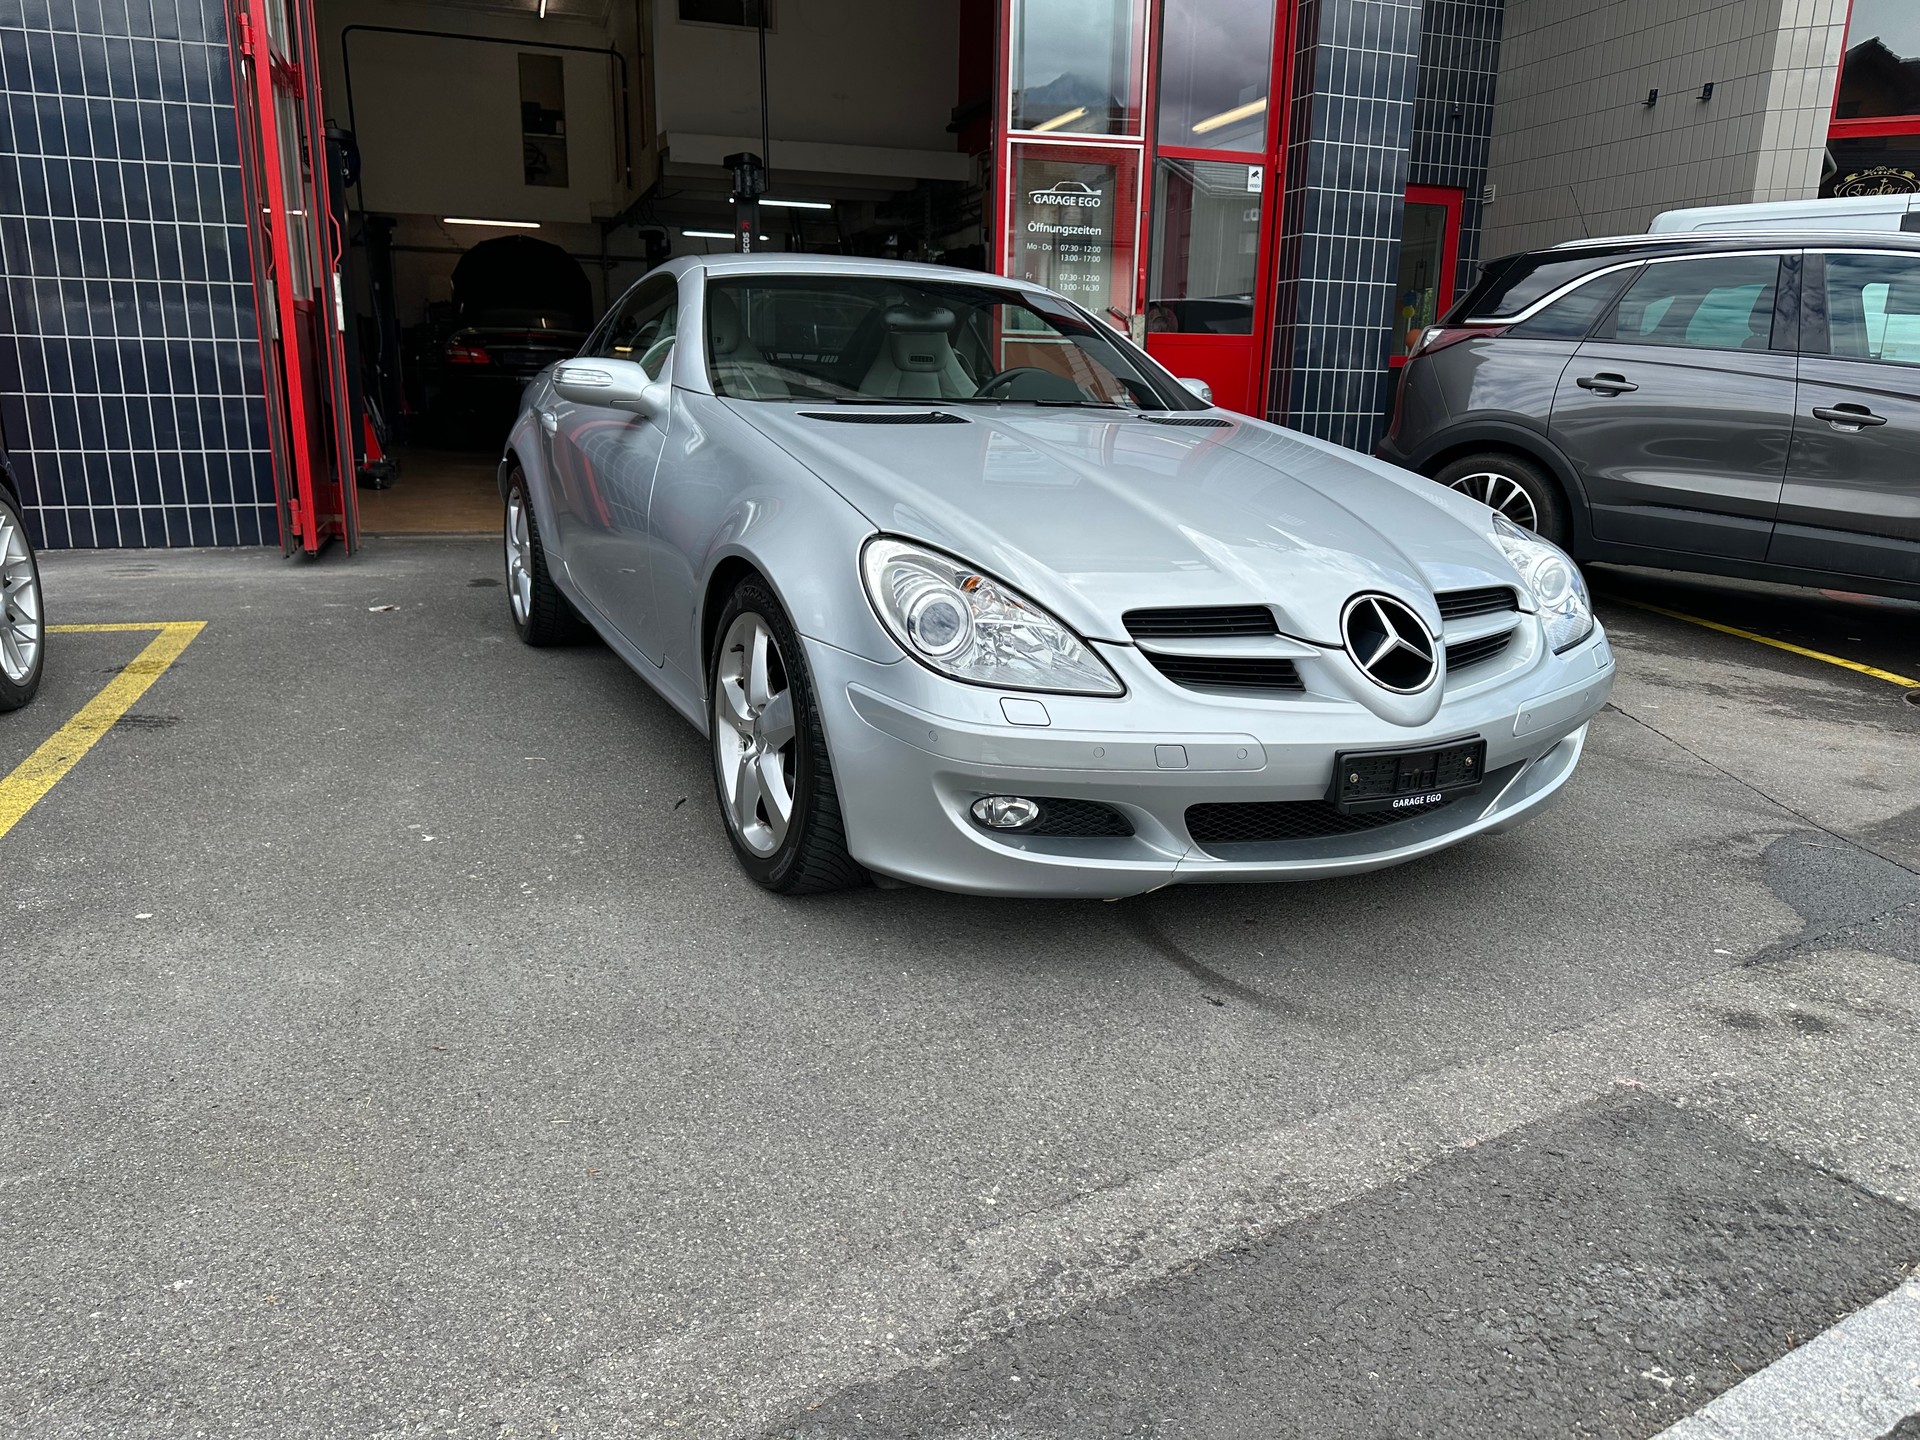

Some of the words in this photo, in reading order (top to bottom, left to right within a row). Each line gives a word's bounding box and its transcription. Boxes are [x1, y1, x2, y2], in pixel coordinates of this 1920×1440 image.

[1033, 194, 1076, 206] GARAGE
[1078, 197, 1101, 208] EGO
[1027, 221, 1102, 236] Öffnungszeiten
[742, 231, 750, 253] SCOS
[1026, 242, 1038, 250] Mo
[1042, 243, 1053, 251] Do
[1060, 244, 1079, 252] 07:30
[1084, 245, 1101, 253] 12:00
[1061, 254, 1078, 262] 13:00
[1083, 255, 1101, 263] 17:00
[1059, 273, 1078, 281] 07:30
[1082, 274, 1100, 282] 12:00
[1060, 283, 1077, 291] 13:00
[1082, 284, 1099, 292] 16:30
[1392, 795, 1425, 808] GARAGE
[1426, 793, 1442, 803] EGO
